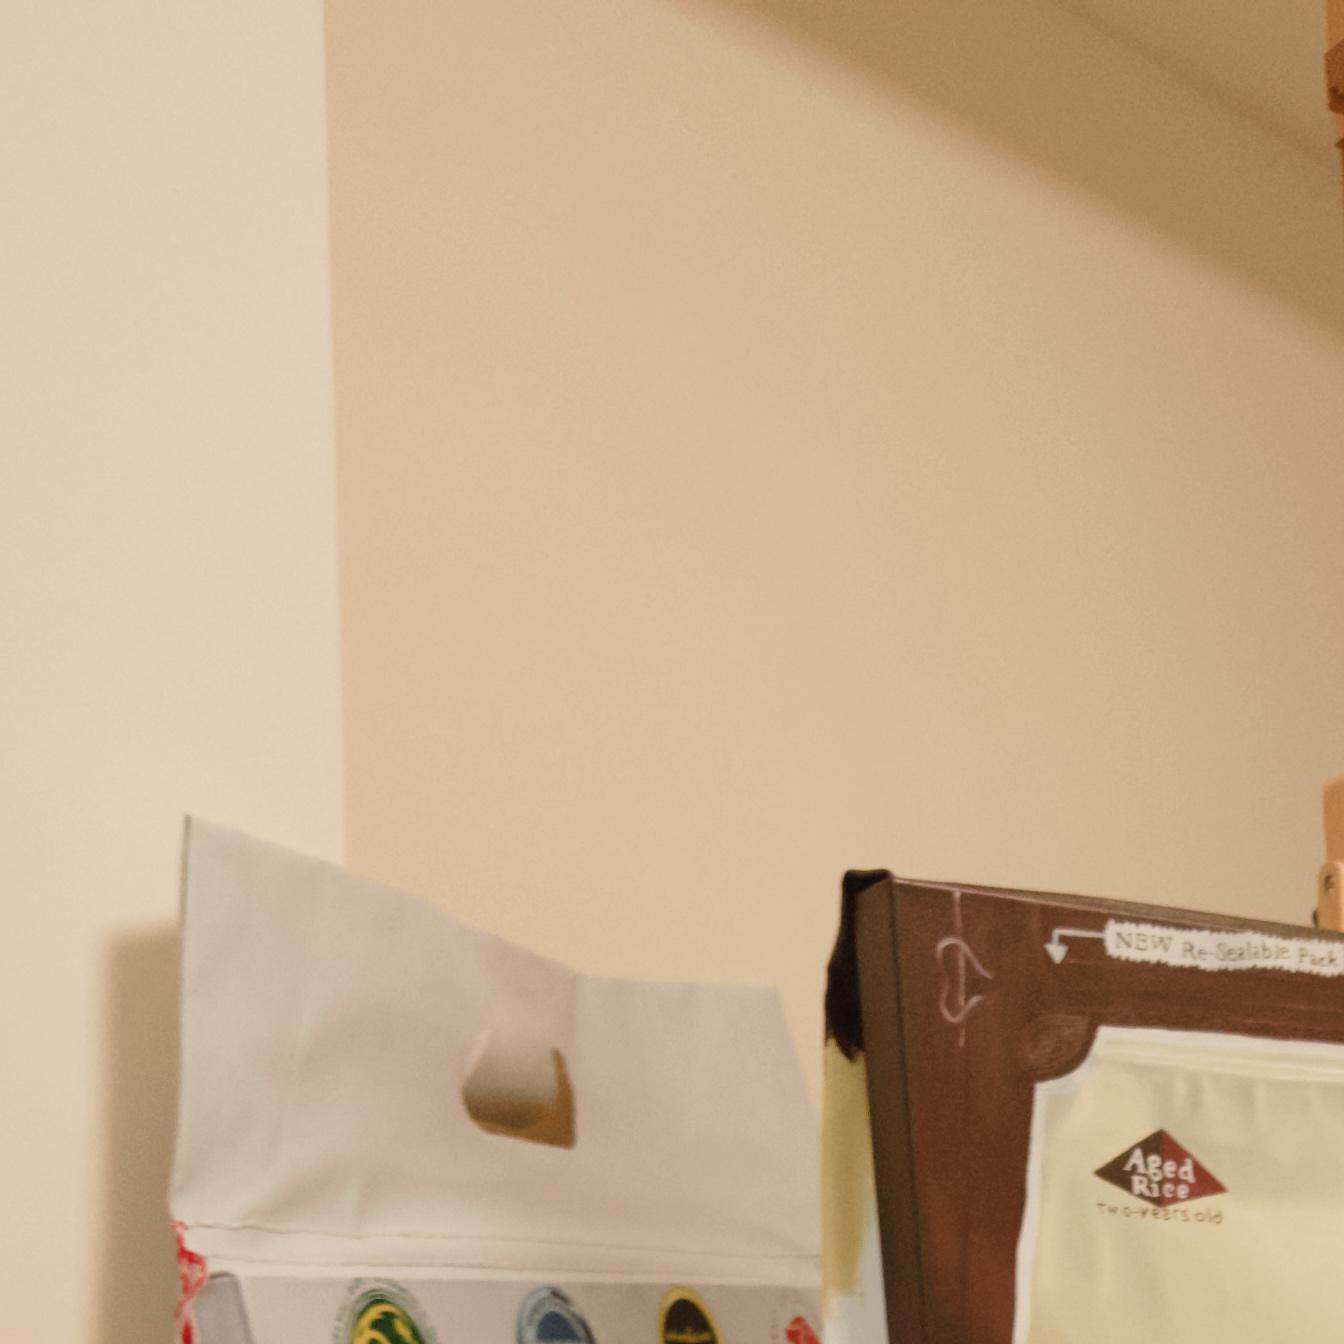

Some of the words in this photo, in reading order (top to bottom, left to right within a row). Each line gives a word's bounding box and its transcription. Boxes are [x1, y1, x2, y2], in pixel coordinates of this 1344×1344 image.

[1114, 931, 1174, 953] NEW
[1122, 1147, 1197, 1184] Aged
[1130, 1175, 1191, 1200] Rice
